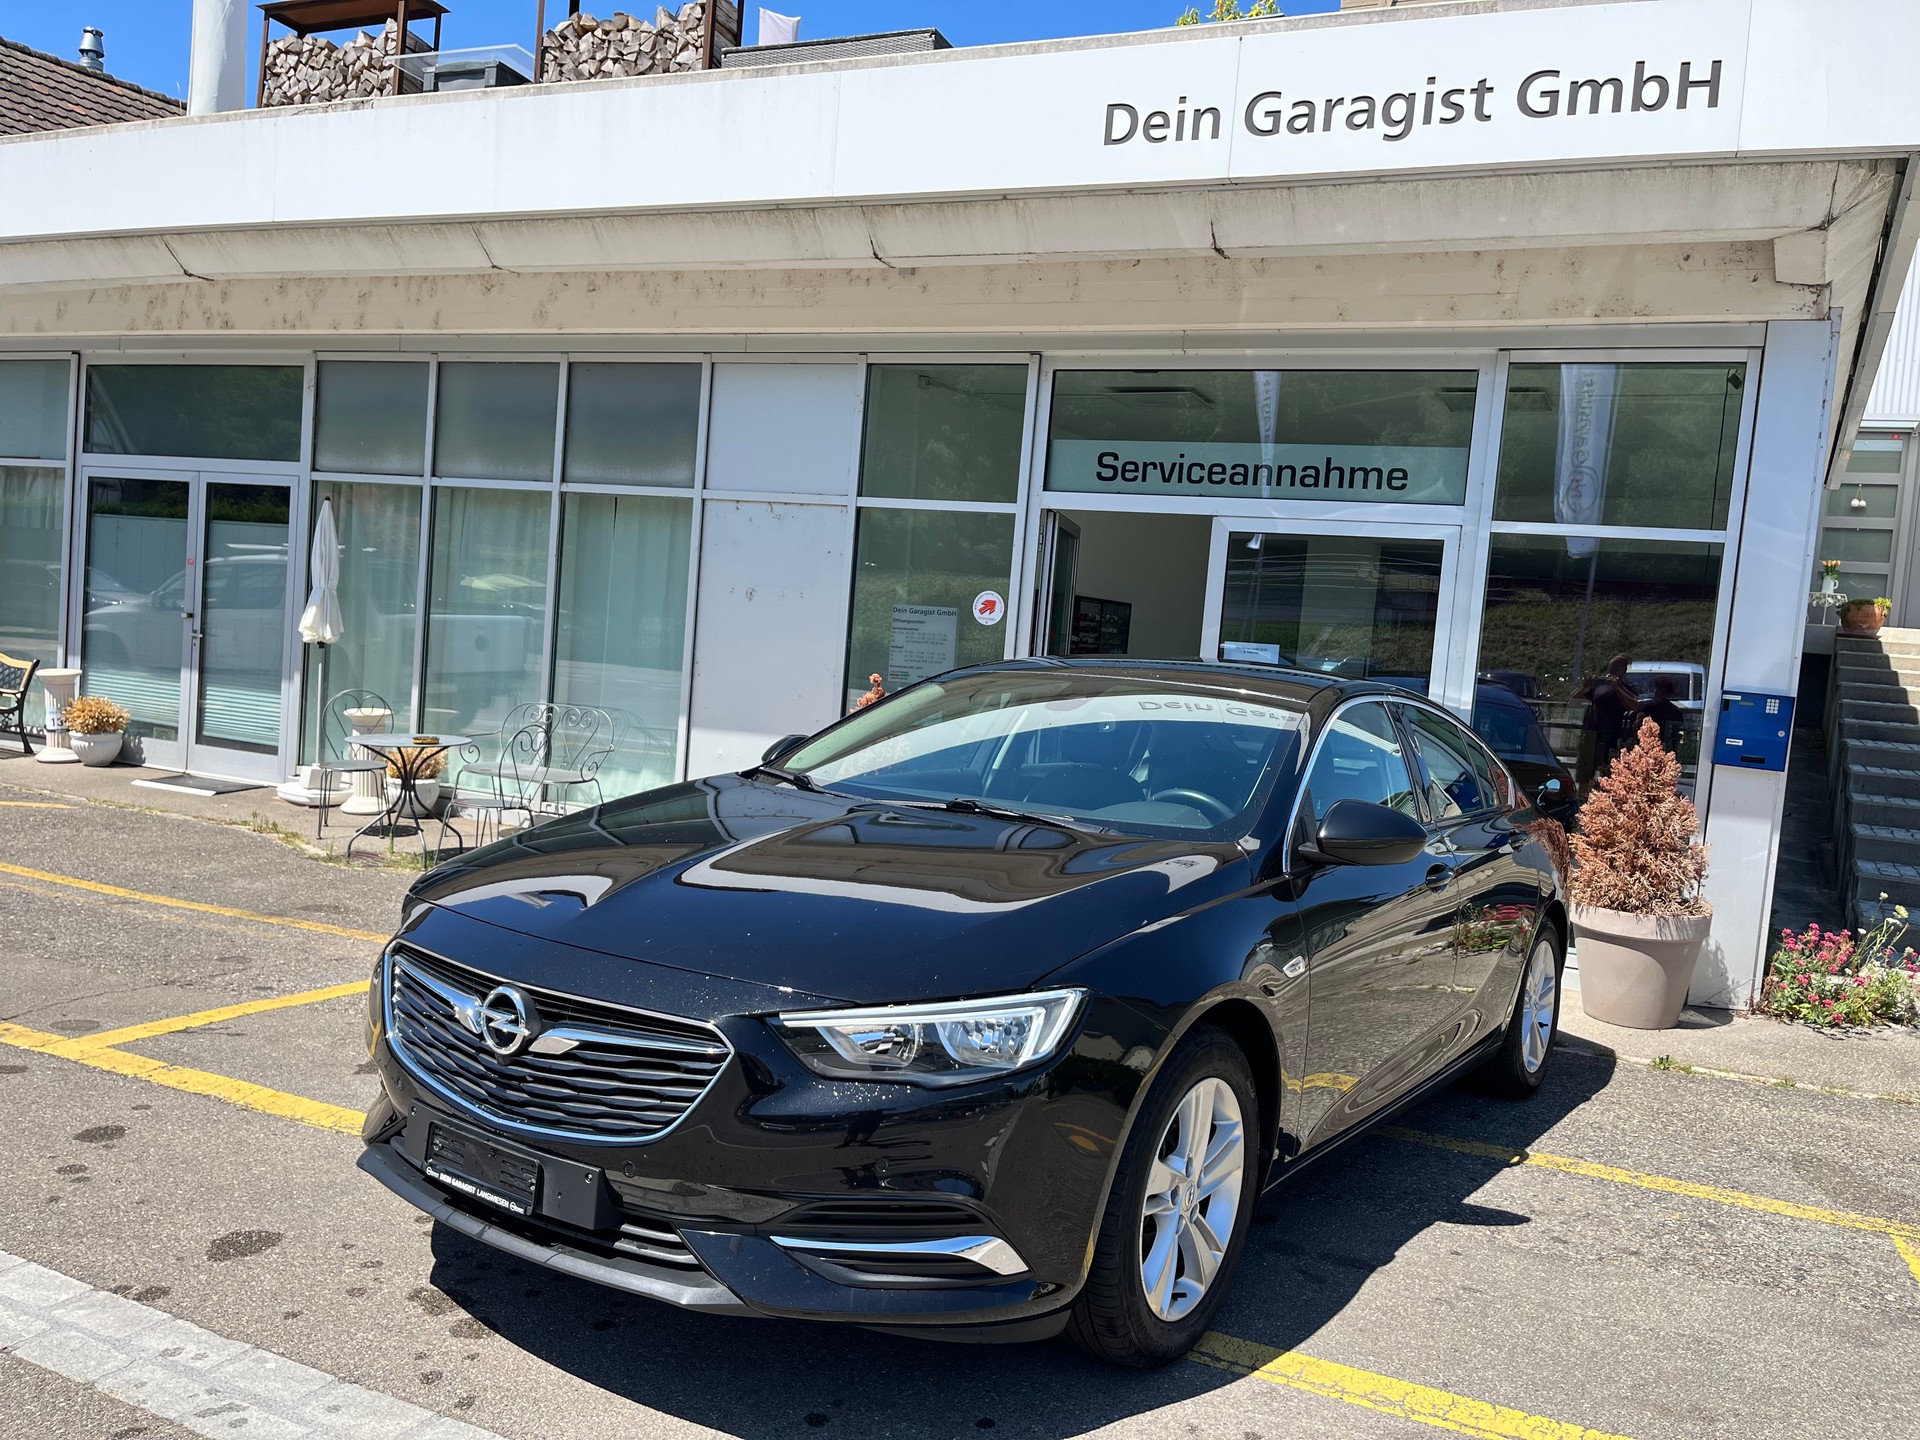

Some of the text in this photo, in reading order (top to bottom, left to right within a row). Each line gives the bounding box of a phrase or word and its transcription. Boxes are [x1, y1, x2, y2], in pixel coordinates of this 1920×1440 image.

[1104, 60, 1723, 146] Dein Garagist GmbH
[1096, 451, 1409, 491] Serviceannahme
[892, 606, 957, 617] Dein Garagist GmbH
